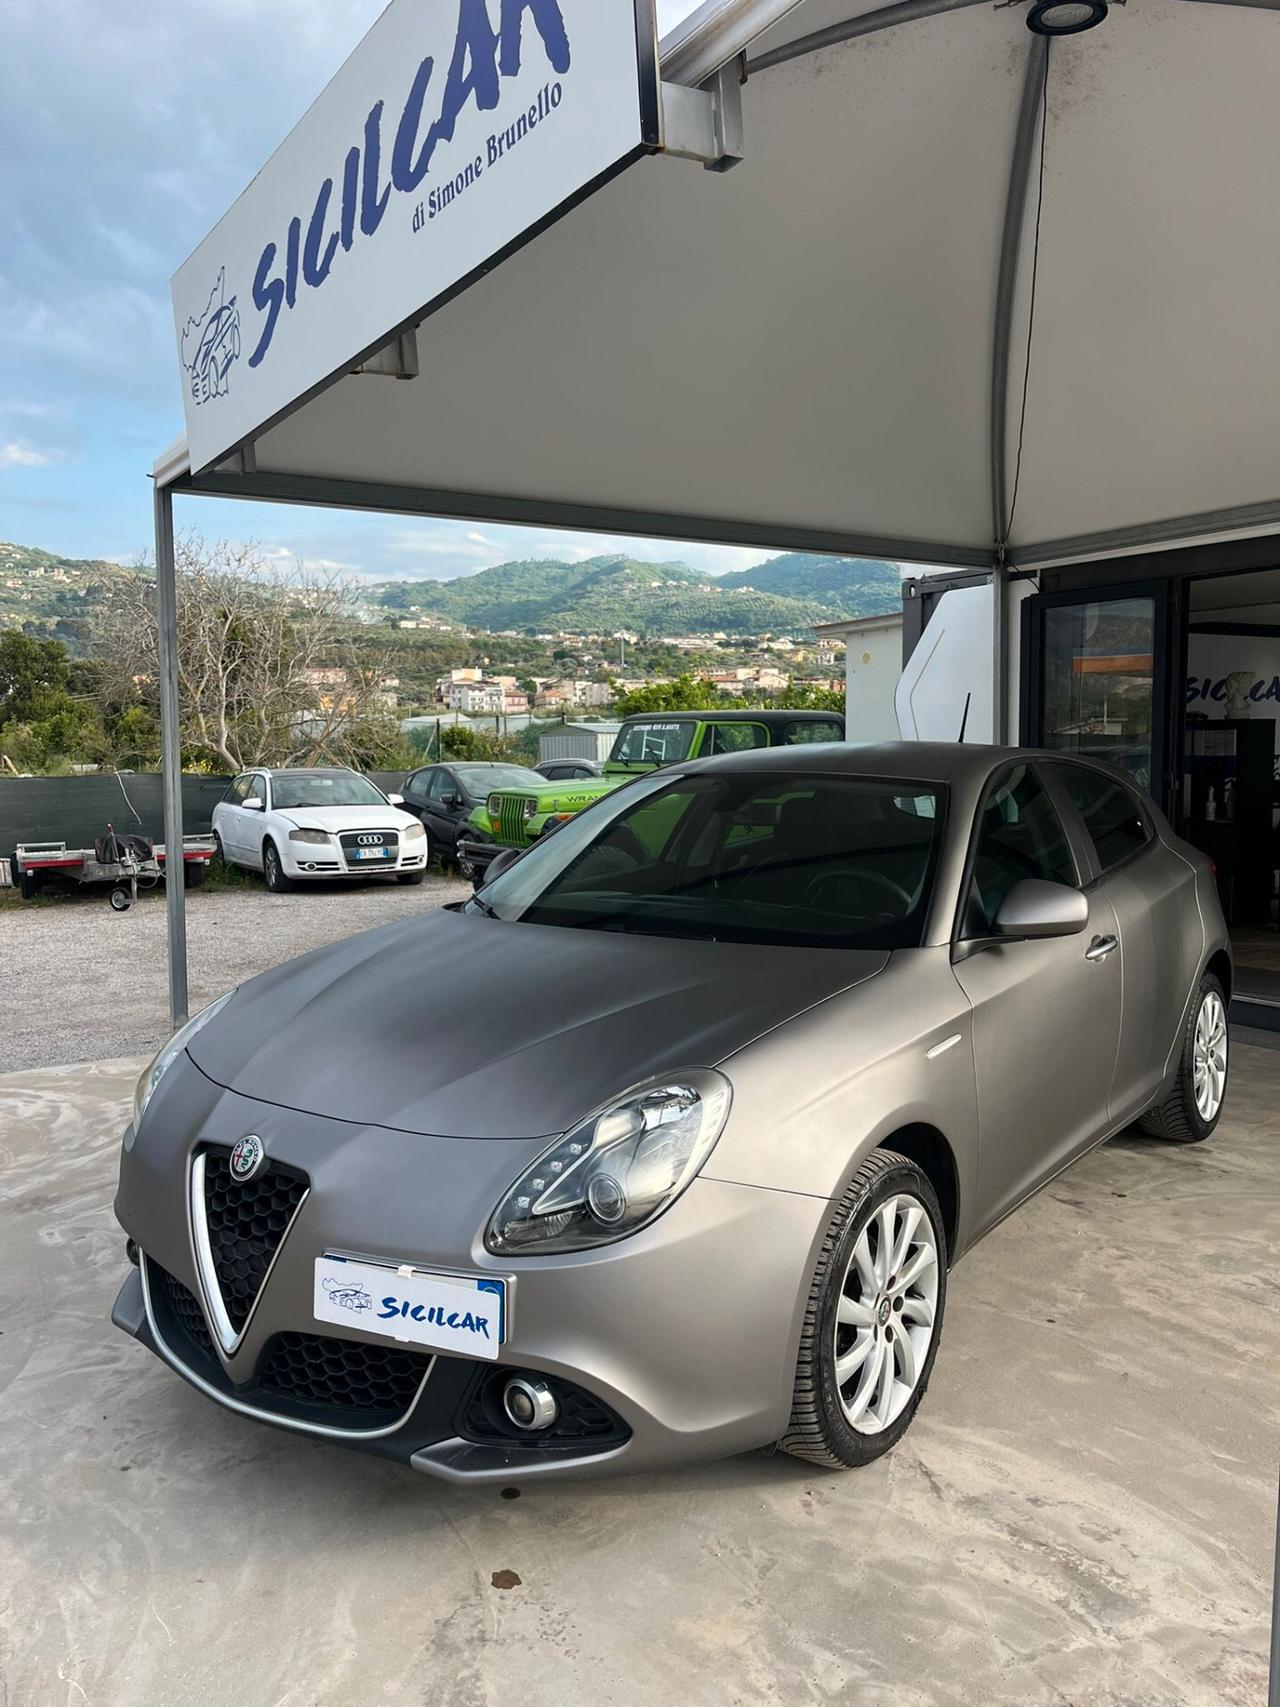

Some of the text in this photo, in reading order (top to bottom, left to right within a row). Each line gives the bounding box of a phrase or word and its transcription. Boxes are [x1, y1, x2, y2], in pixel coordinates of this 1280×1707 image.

[411, 81, 563, 234] di Simone Brunello
[376, 1296, 490, 1340] SICILCAR
